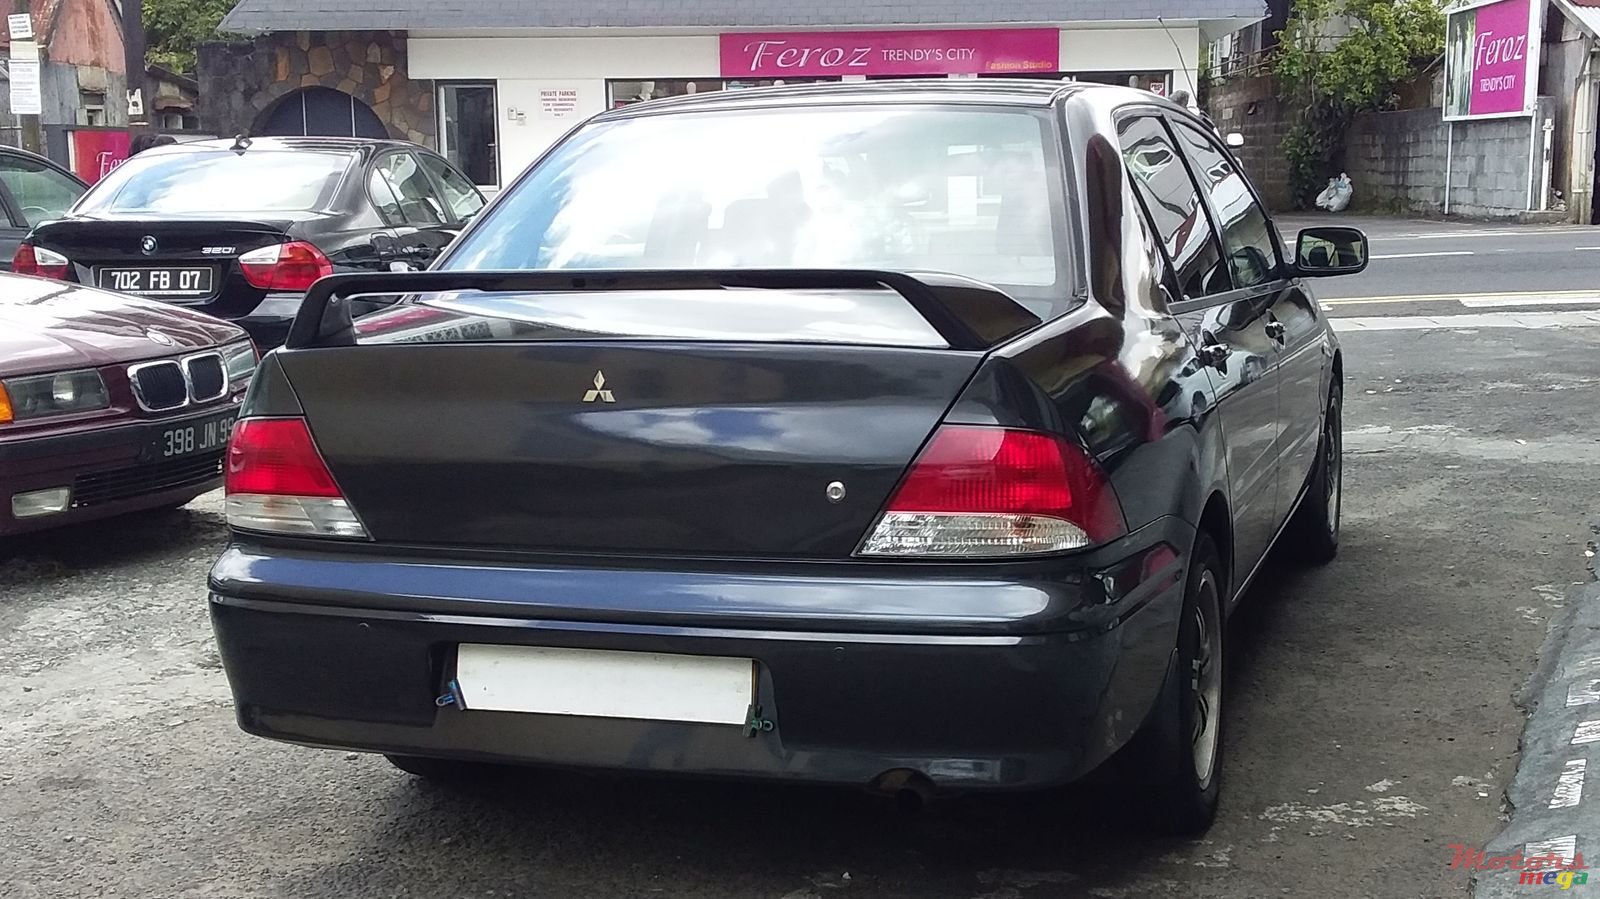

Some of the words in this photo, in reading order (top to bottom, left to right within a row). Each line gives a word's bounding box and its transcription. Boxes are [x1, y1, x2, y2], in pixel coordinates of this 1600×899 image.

[743, 40, 871, 71] Feroz
[881, 48, 943, 61] TRENDY'S
[946, 48, 975, 59] CITY
[1023, 60, 1053, 69] Studio
[1475, 31, 1525, 70] Feroz
[111, 271, 141, 289] 702
[150, 271, 170, 289] FB
[179, 271, 200, 289] 07
[164, 427, 195, 457] 398
[200, 422, 217, 449] JN
